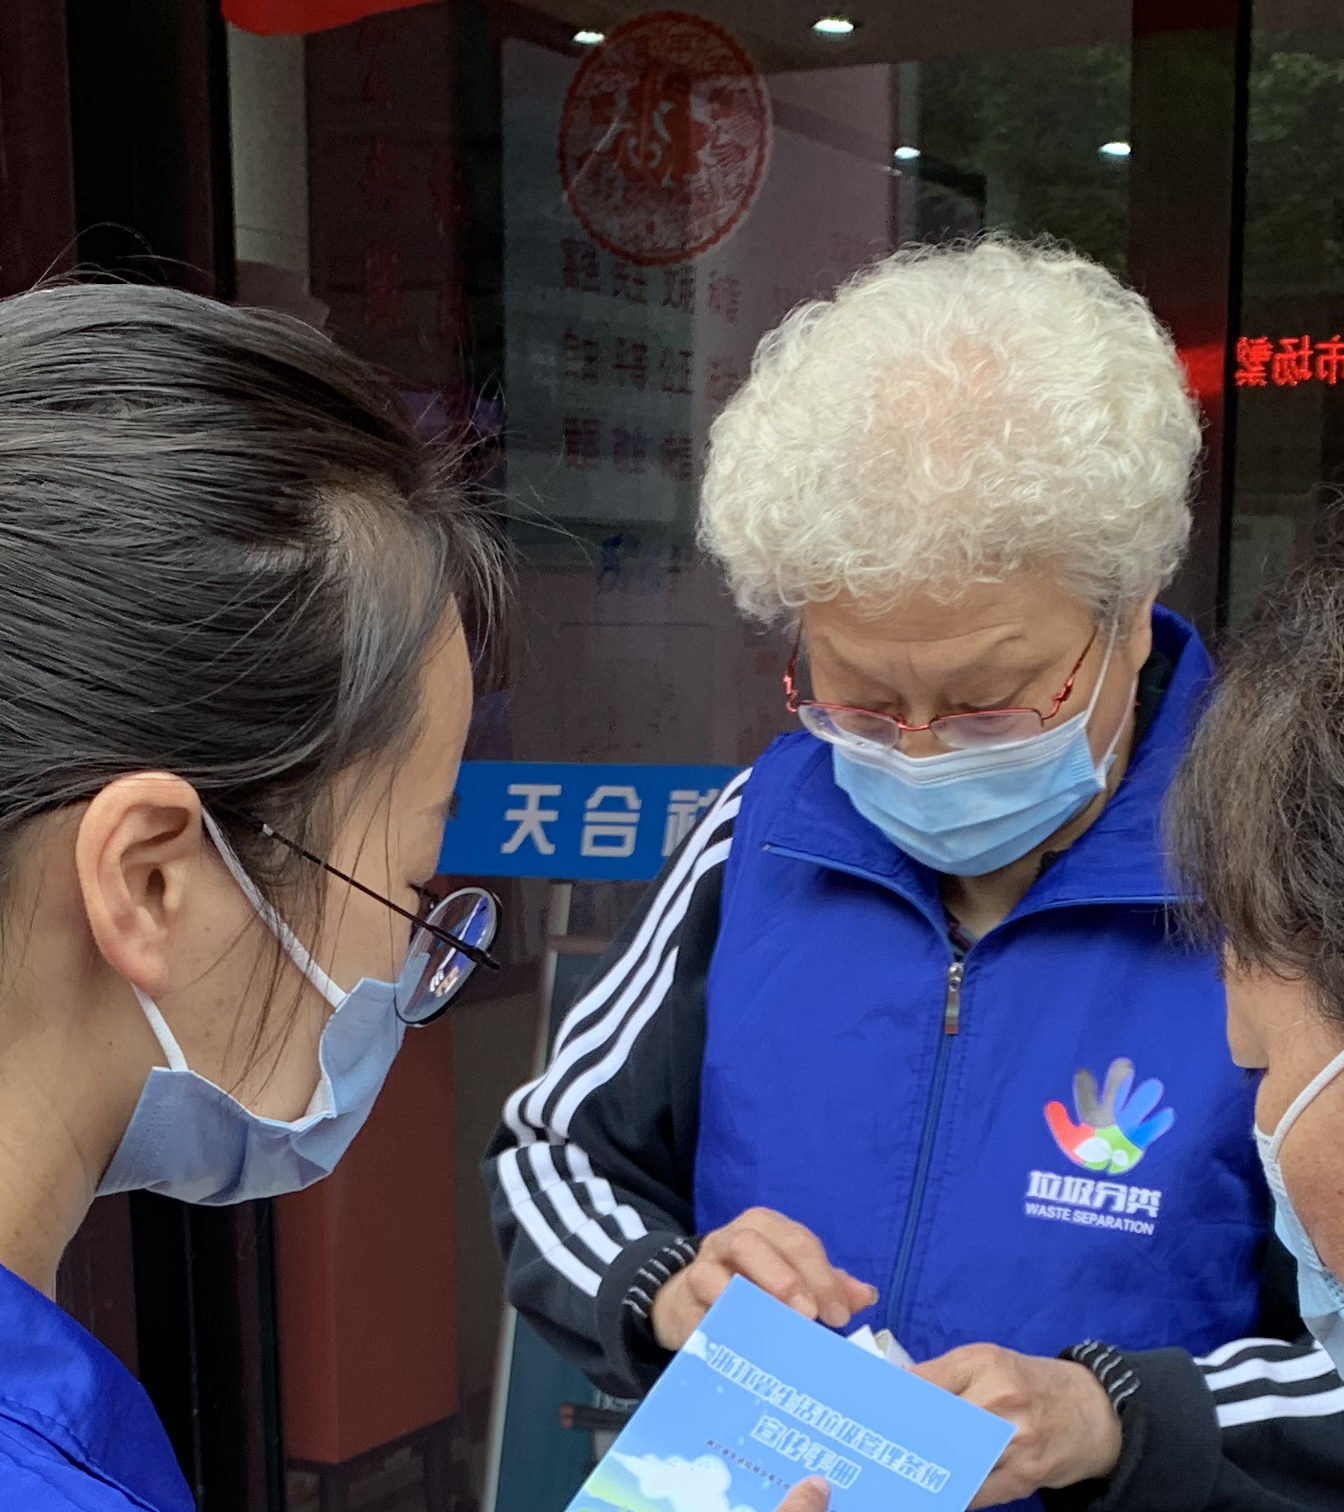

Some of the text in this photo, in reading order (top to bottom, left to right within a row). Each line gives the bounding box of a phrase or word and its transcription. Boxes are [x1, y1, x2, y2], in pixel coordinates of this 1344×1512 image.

[1027, 1170, 1162, 1218] 垃圾分类
[1025, 1202, 1155, 1236] WASTE SEPARATION
[749, 1416, 863, 1490] 宣传手册
